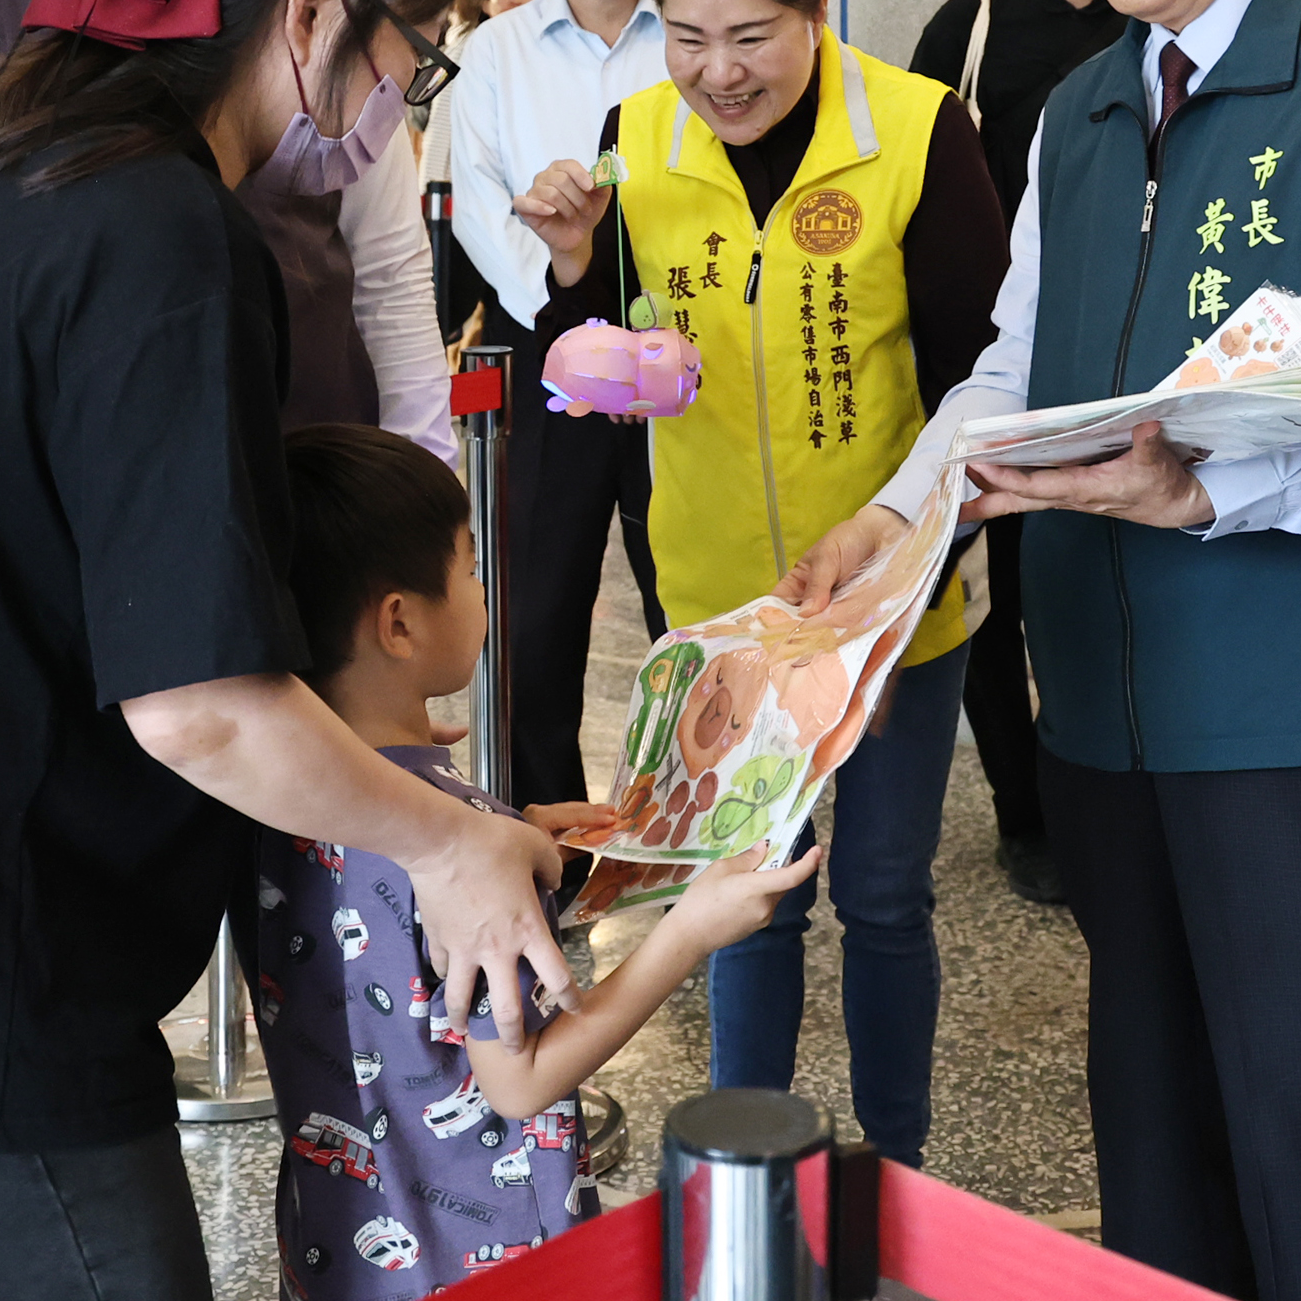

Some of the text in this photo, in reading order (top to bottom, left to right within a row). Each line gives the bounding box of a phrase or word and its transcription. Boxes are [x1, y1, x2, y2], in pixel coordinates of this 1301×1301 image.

[1241, 146, 1285, 248] 市長
[699, 231, 728, 290] 會長
[667, 265, 703, 390] 張慧
[799, 261, 828, 450] 公有零售市場自治會
[826, 262, 858, 445] 臺南市西門淺草
[410, 1180, 496, 1225] TOMICA1970
